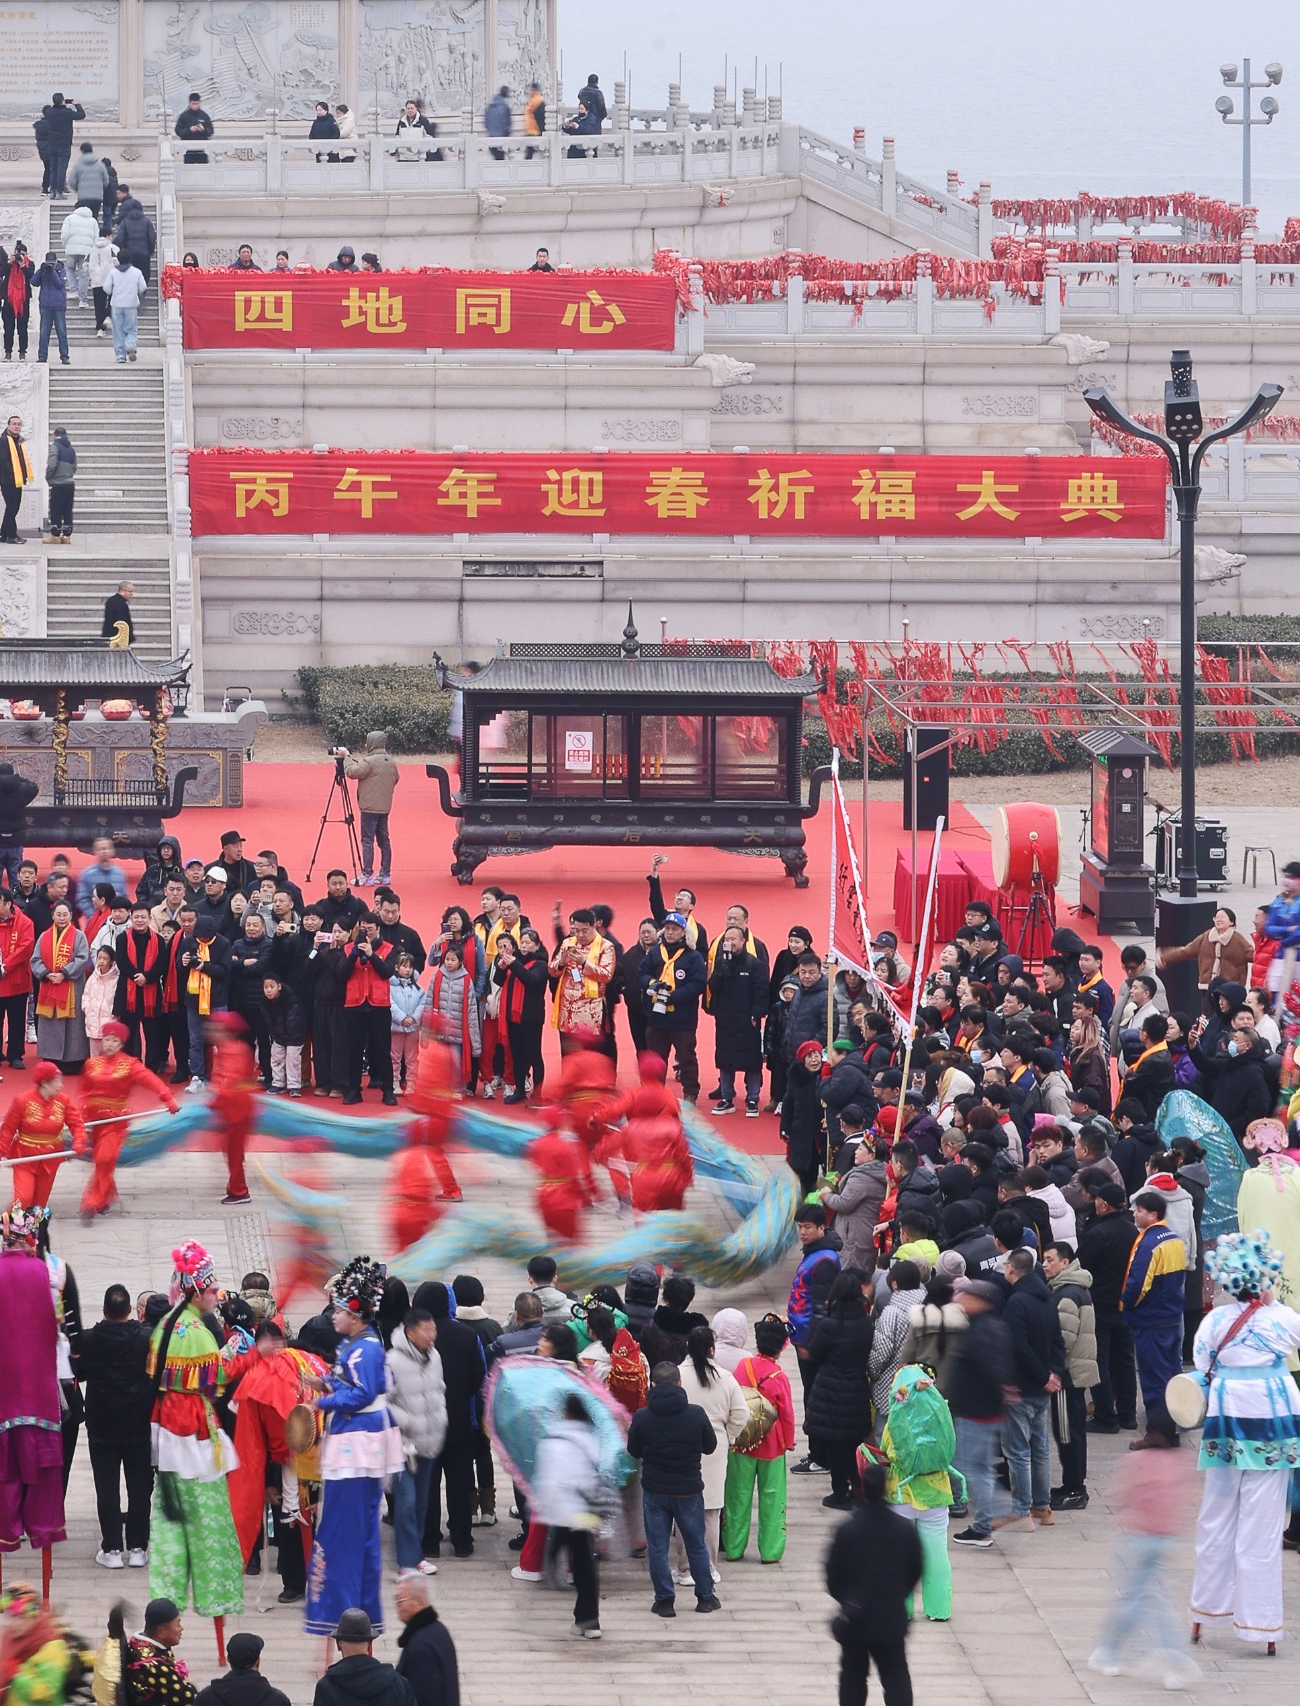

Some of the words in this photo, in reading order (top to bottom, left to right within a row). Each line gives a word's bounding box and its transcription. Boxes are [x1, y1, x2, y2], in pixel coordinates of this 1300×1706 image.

[234, 287, 626, 334] 四地同心
[229, 467, 1125, 522] 丙午年迎春祈福大典
